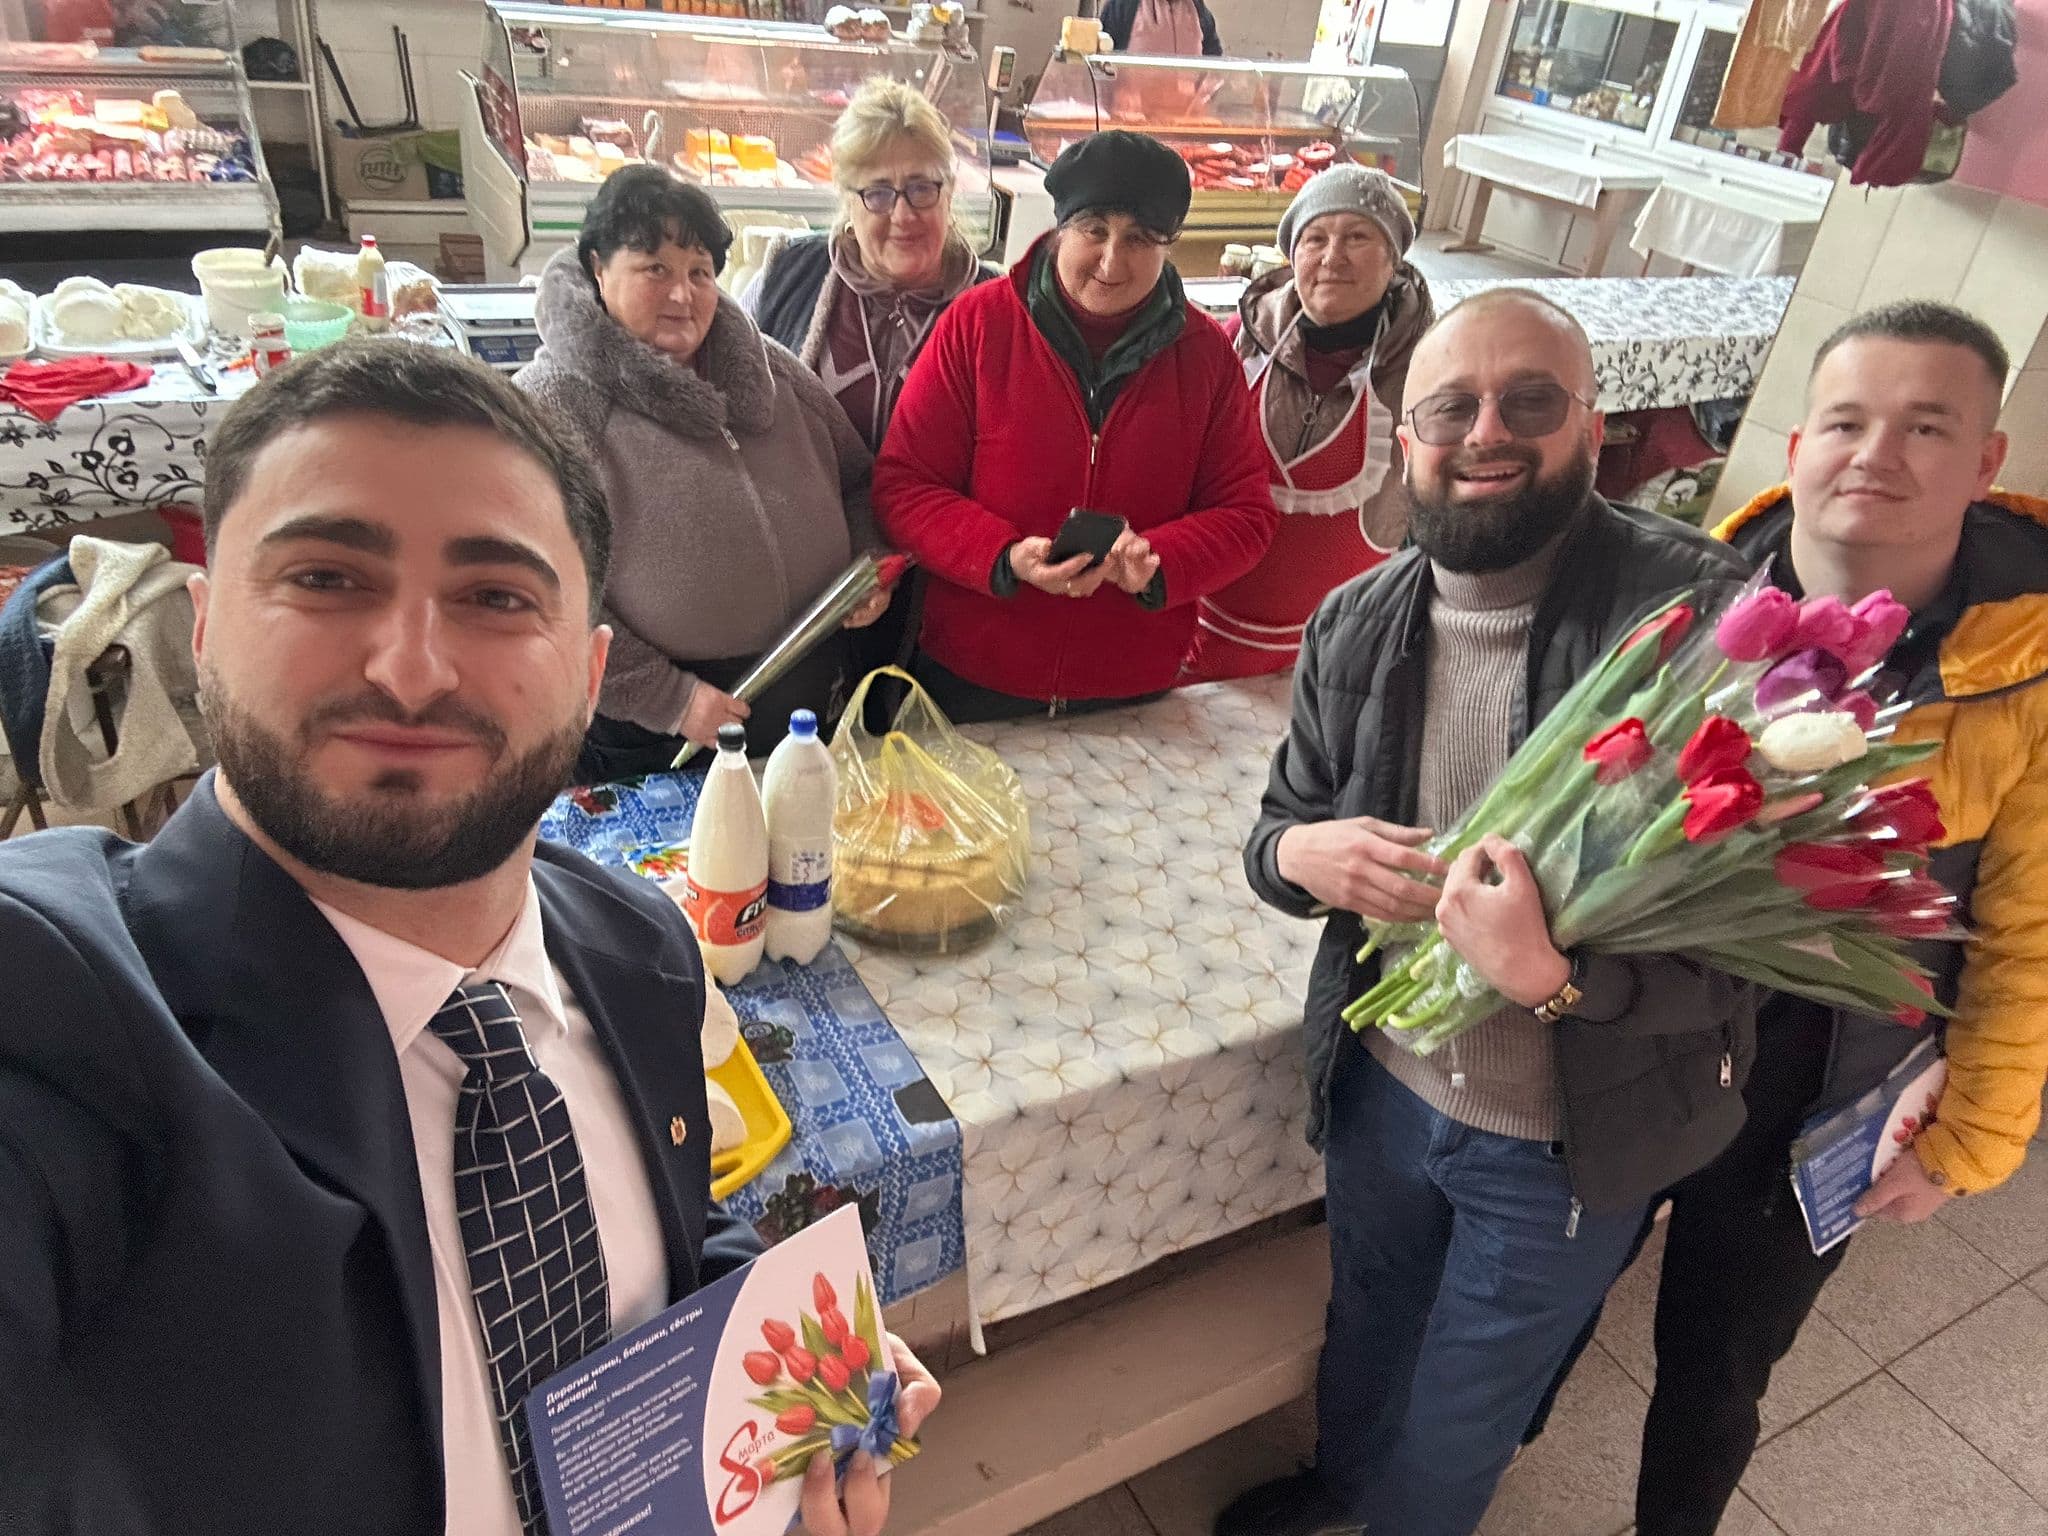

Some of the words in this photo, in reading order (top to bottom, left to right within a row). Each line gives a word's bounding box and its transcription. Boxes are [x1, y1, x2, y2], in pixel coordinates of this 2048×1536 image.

[546, 1373, 590, 1407] Дорогие
[623, 1328, 669, 1360] бабушки,
[715, 1420, 760, 1526] 8
